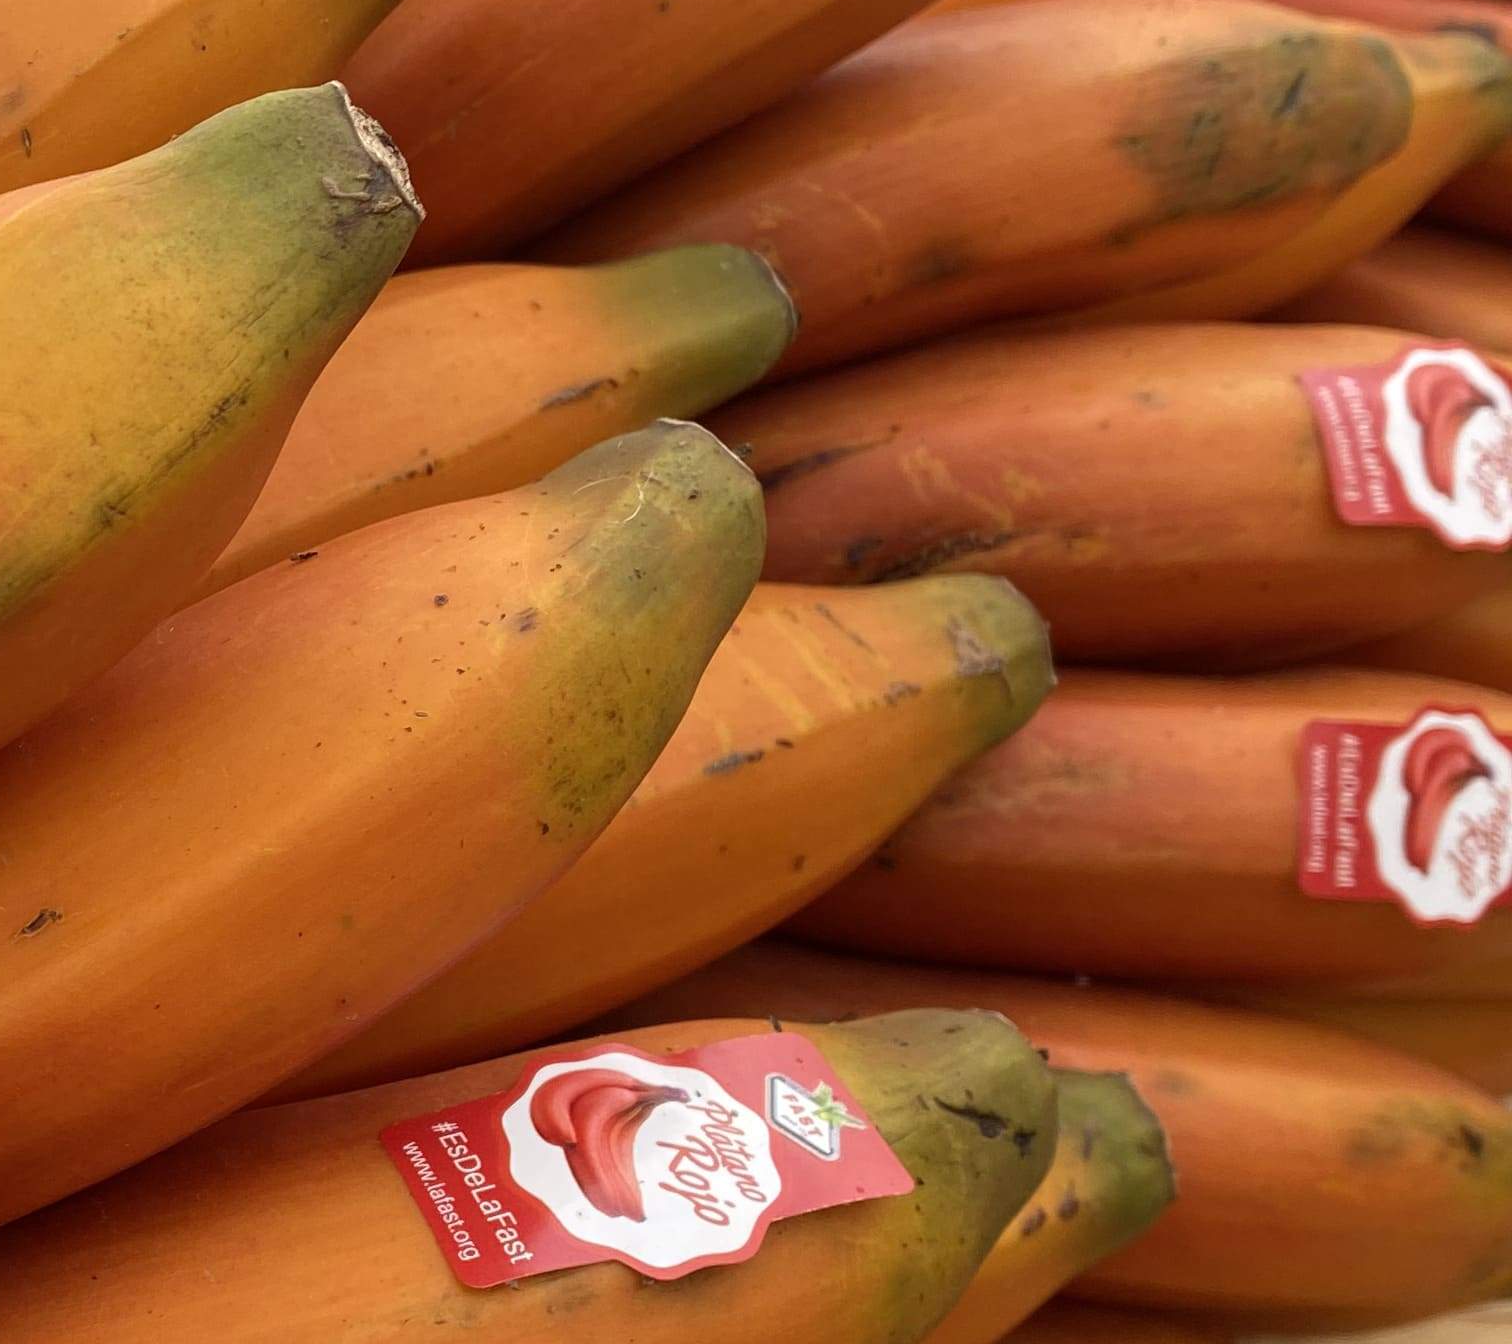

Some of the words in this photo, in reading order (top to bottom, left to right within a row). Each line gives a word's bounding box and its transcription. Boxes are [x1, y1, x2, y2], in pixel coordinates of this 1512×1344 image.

[699, 1099, 767, 1204] Plátano
[782, 1094, 824, 1137] FAST
[402, 1141, 480, 1263] www.lafast.org
[431, 1121, 534, 1265] #EsDeLaFast
[656, 1135, 730, 1226] Rojo
